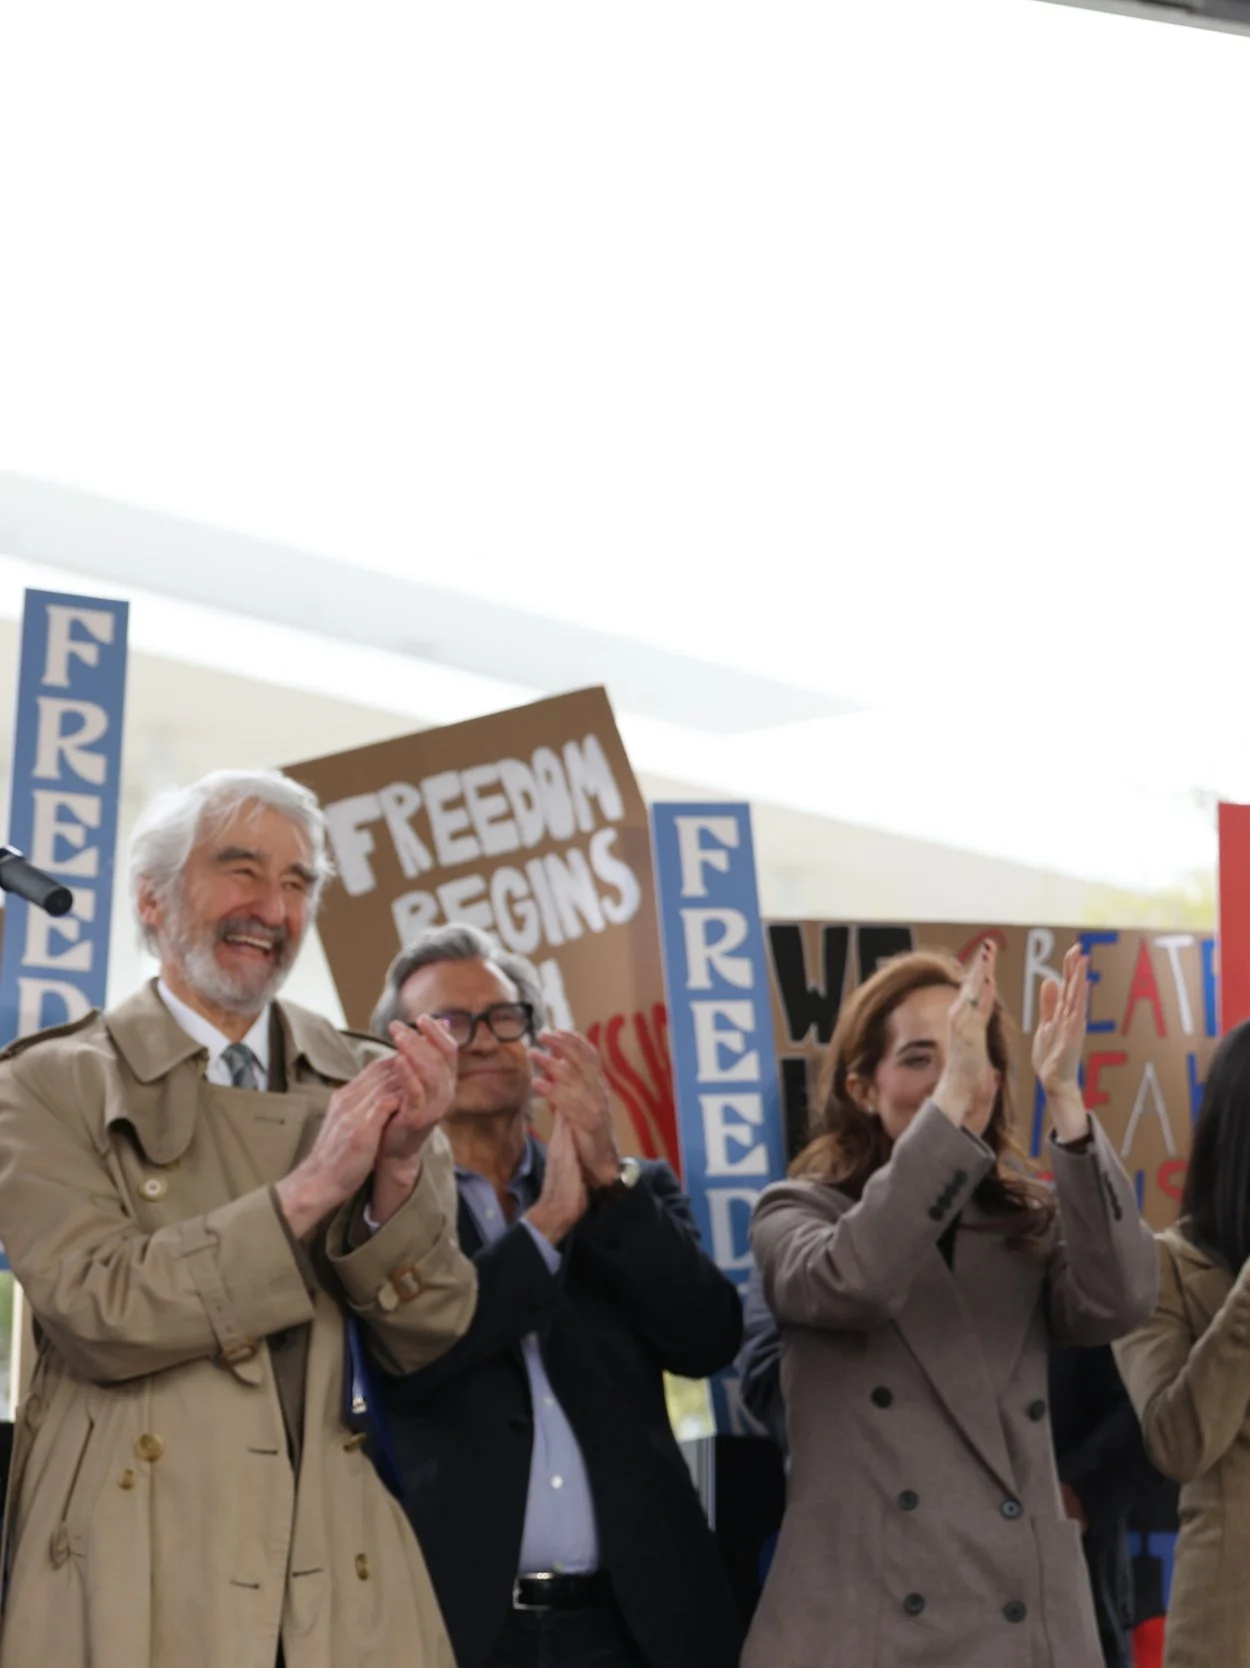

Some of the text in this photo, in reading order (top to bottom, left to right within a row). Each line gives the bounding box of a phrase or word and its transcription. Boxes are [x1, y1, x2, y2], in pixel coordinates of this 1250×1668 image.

[324, 733, 624, 897] FREEDOM
[392, 827, 641, 955] BEGINS
[956, 928, 1219, 1039] REAT
[674, 815, 769, 1435] FREED
